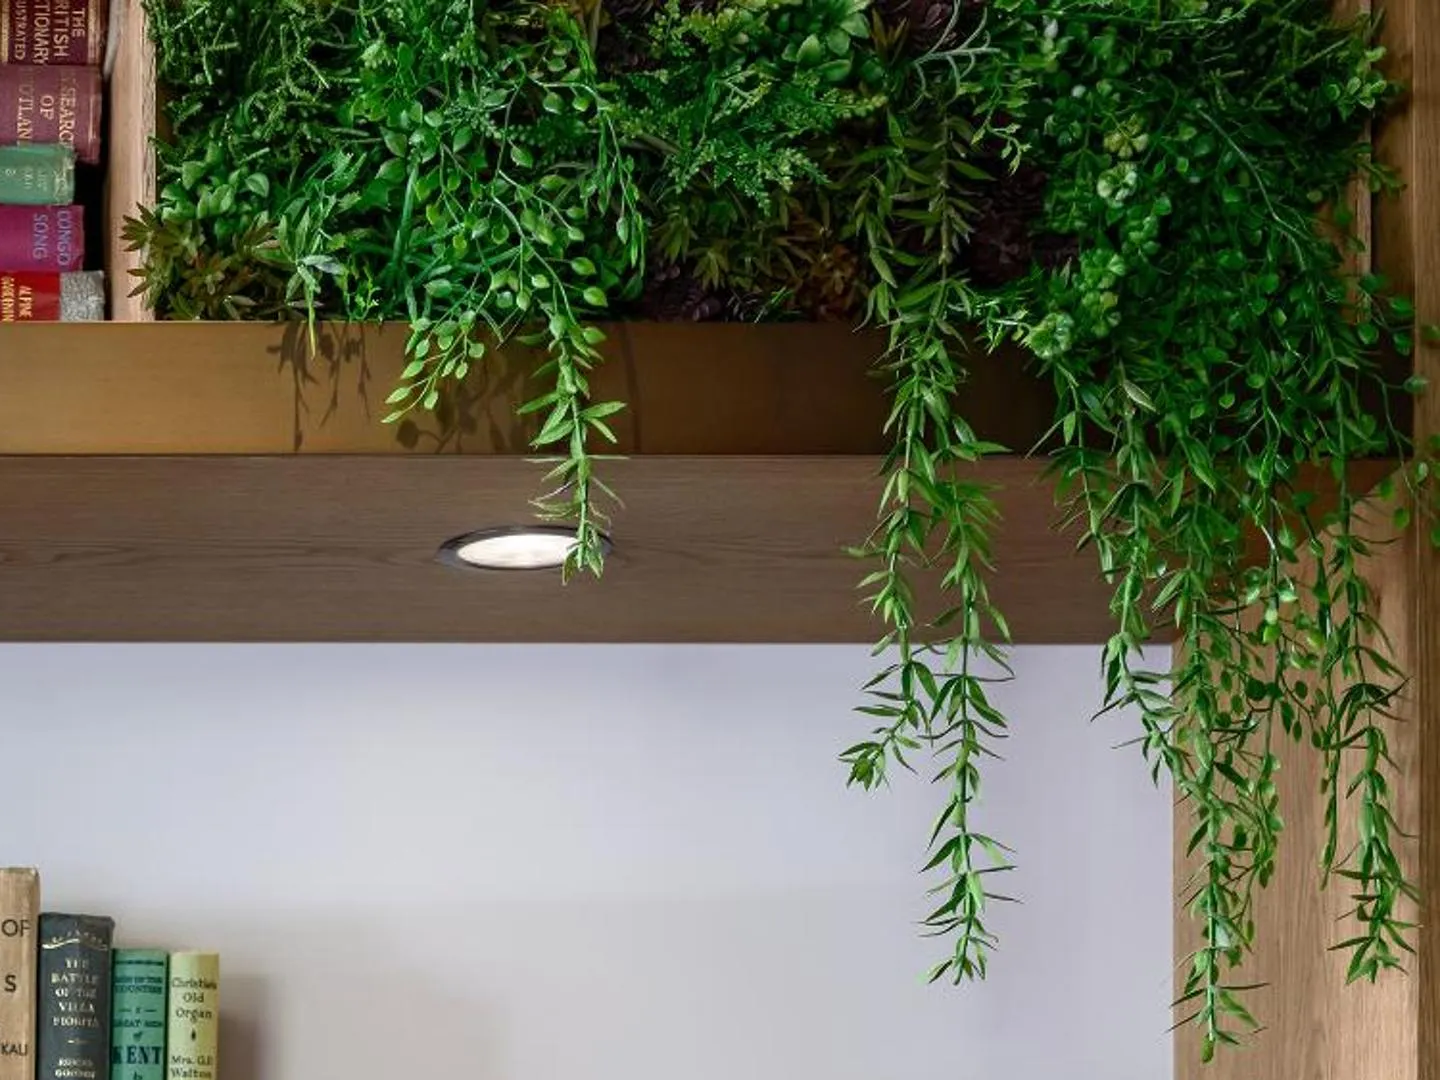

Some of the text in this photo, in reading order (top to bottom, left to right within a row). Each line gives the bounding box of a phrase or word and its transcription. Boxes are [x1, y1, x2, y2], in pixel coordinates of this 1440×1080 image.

[33, 0, 50, 65] TIONARY
[71, 8, 85, 38] THE
[39, 94, 55, 121] OF
[32, 213, 49, 260] SONG
[57, 208, 73, 265] CONGO
[1, 918, 31, 938] OF
[58, 1001, 96, 1014] VILLA
[183, 991, 204, 1004] Old
[176, 1008, 213, 1023] Organ
[112, 1046, 163, 1065] KENT
